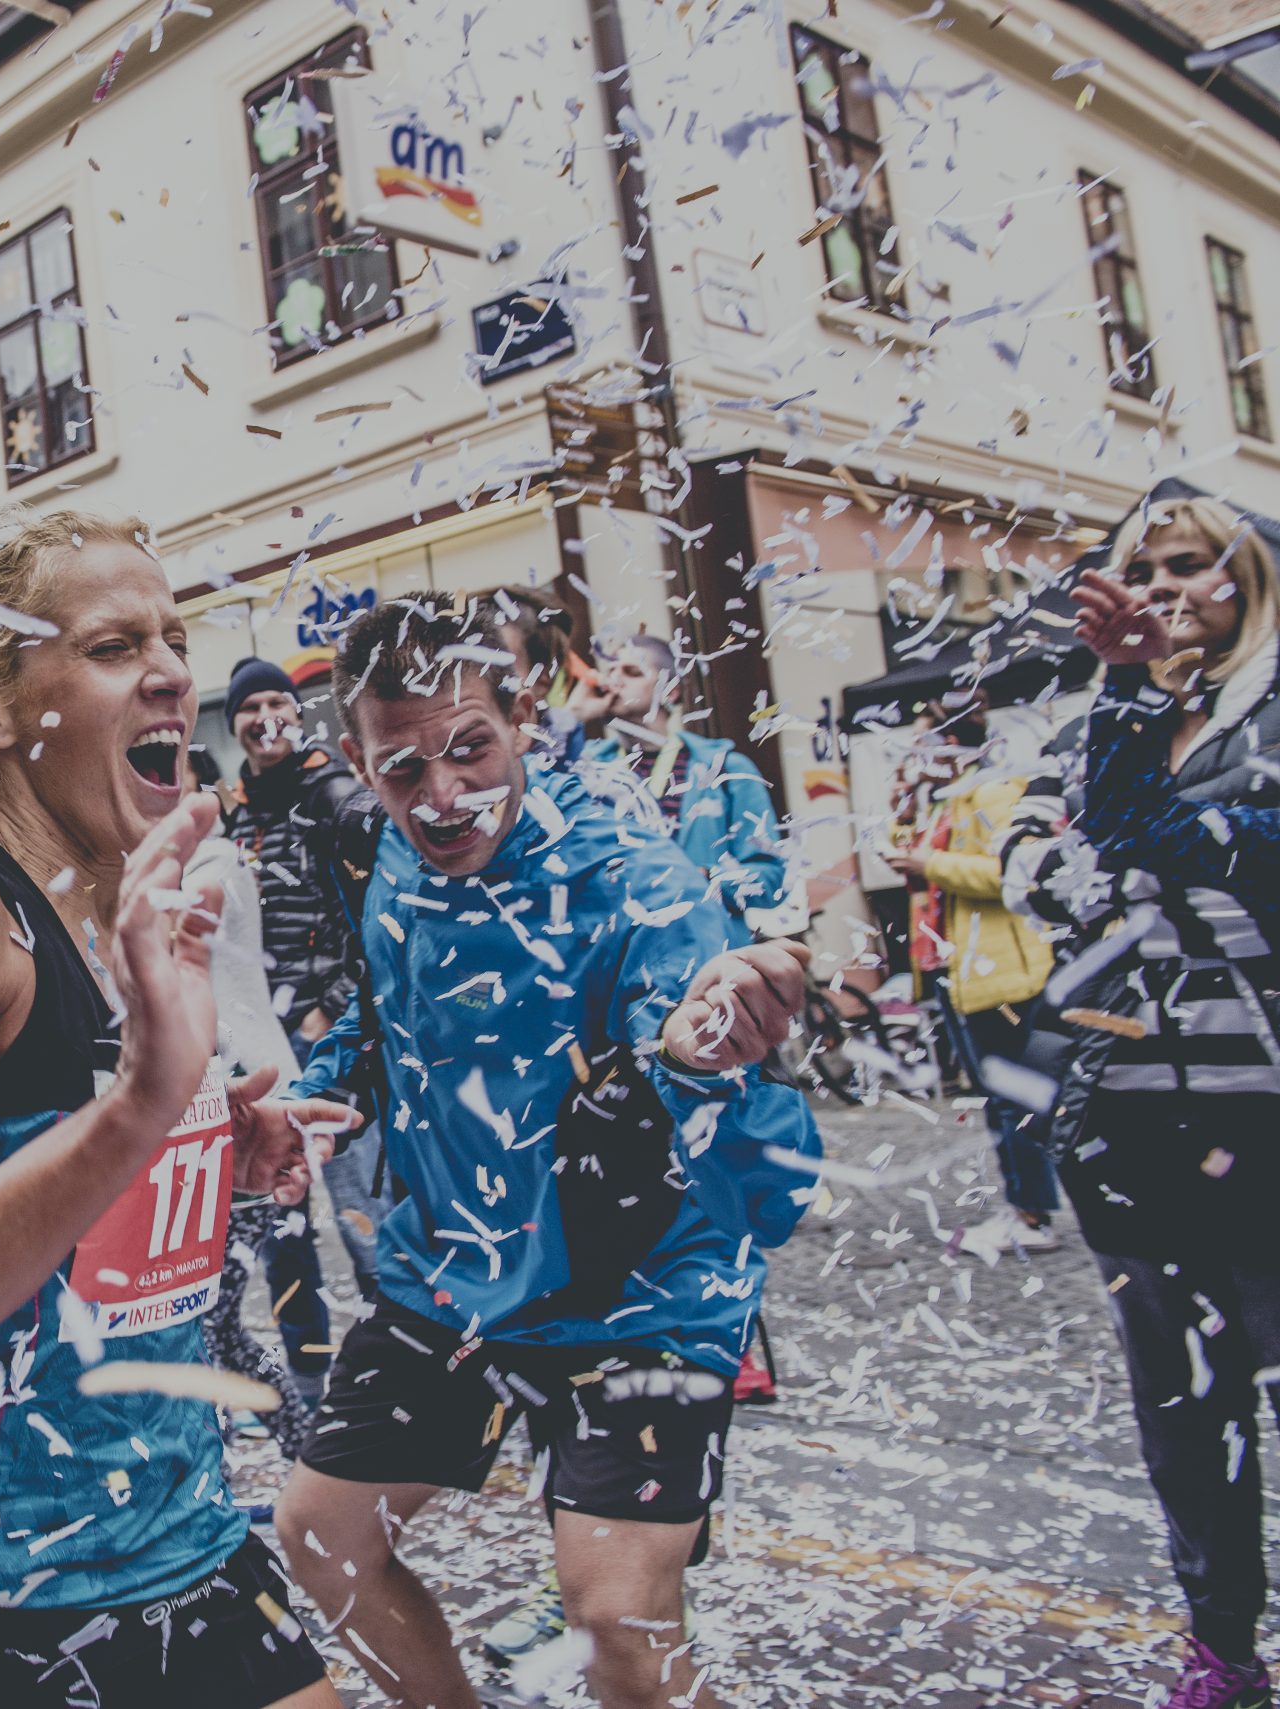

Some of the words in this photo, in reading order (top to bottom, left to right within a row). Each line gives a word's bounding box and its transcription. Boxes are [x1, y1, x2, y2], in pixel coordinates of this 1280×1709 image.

[148, 1136, 226, 1259] 171
[160, 1269, 173, 1282] km
[176, 1256, 209, 1276] MARATON
[128, 1287, 210, 1328] INTERSPORT
